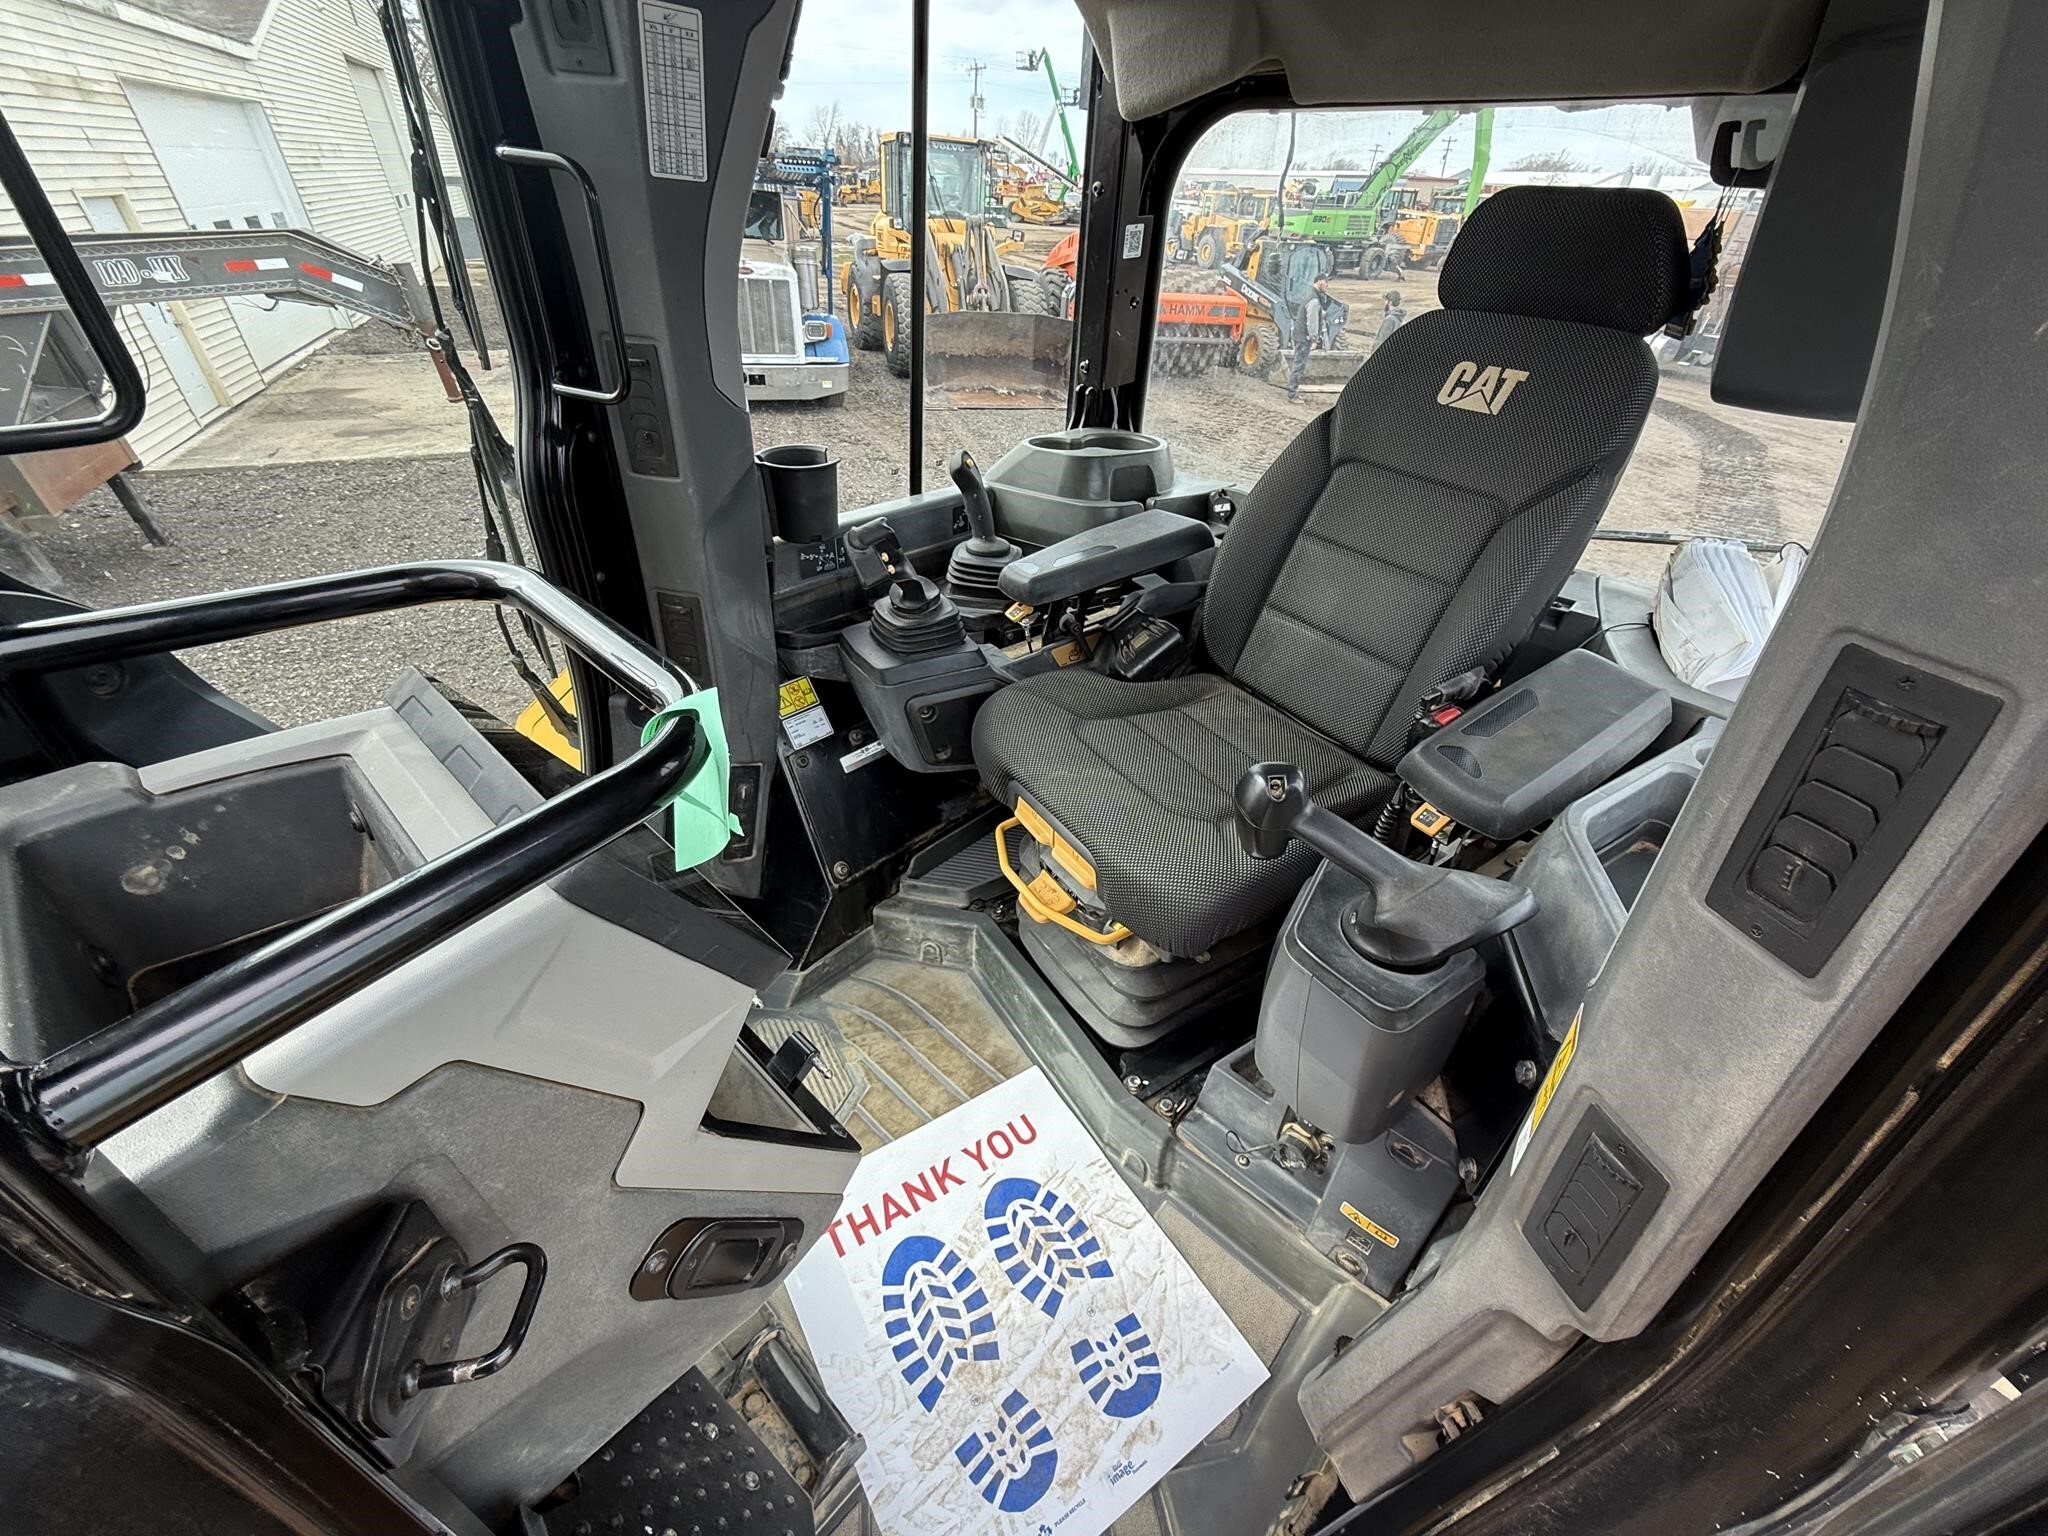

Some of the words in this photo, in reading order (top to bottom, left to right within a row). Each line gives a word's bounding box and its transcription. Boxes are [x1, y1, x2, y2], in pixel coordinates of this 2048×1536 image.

[933, 142, 965, 152] VOLVO
[93, 259, 141, 287] LOAD
[1169, 304, 1205, 315] HAMM
[1437, 361, 1530, 416] CAT
[826, 1156, 966, 1259] THANK
[960, 1113, 1037, 1172] YOU
[1108, 1460, 1135, 1486] image
[1054, 1512, 1070, 1528] PLEASE
[1069, 1498, 1087, 1515] RECYCLE
